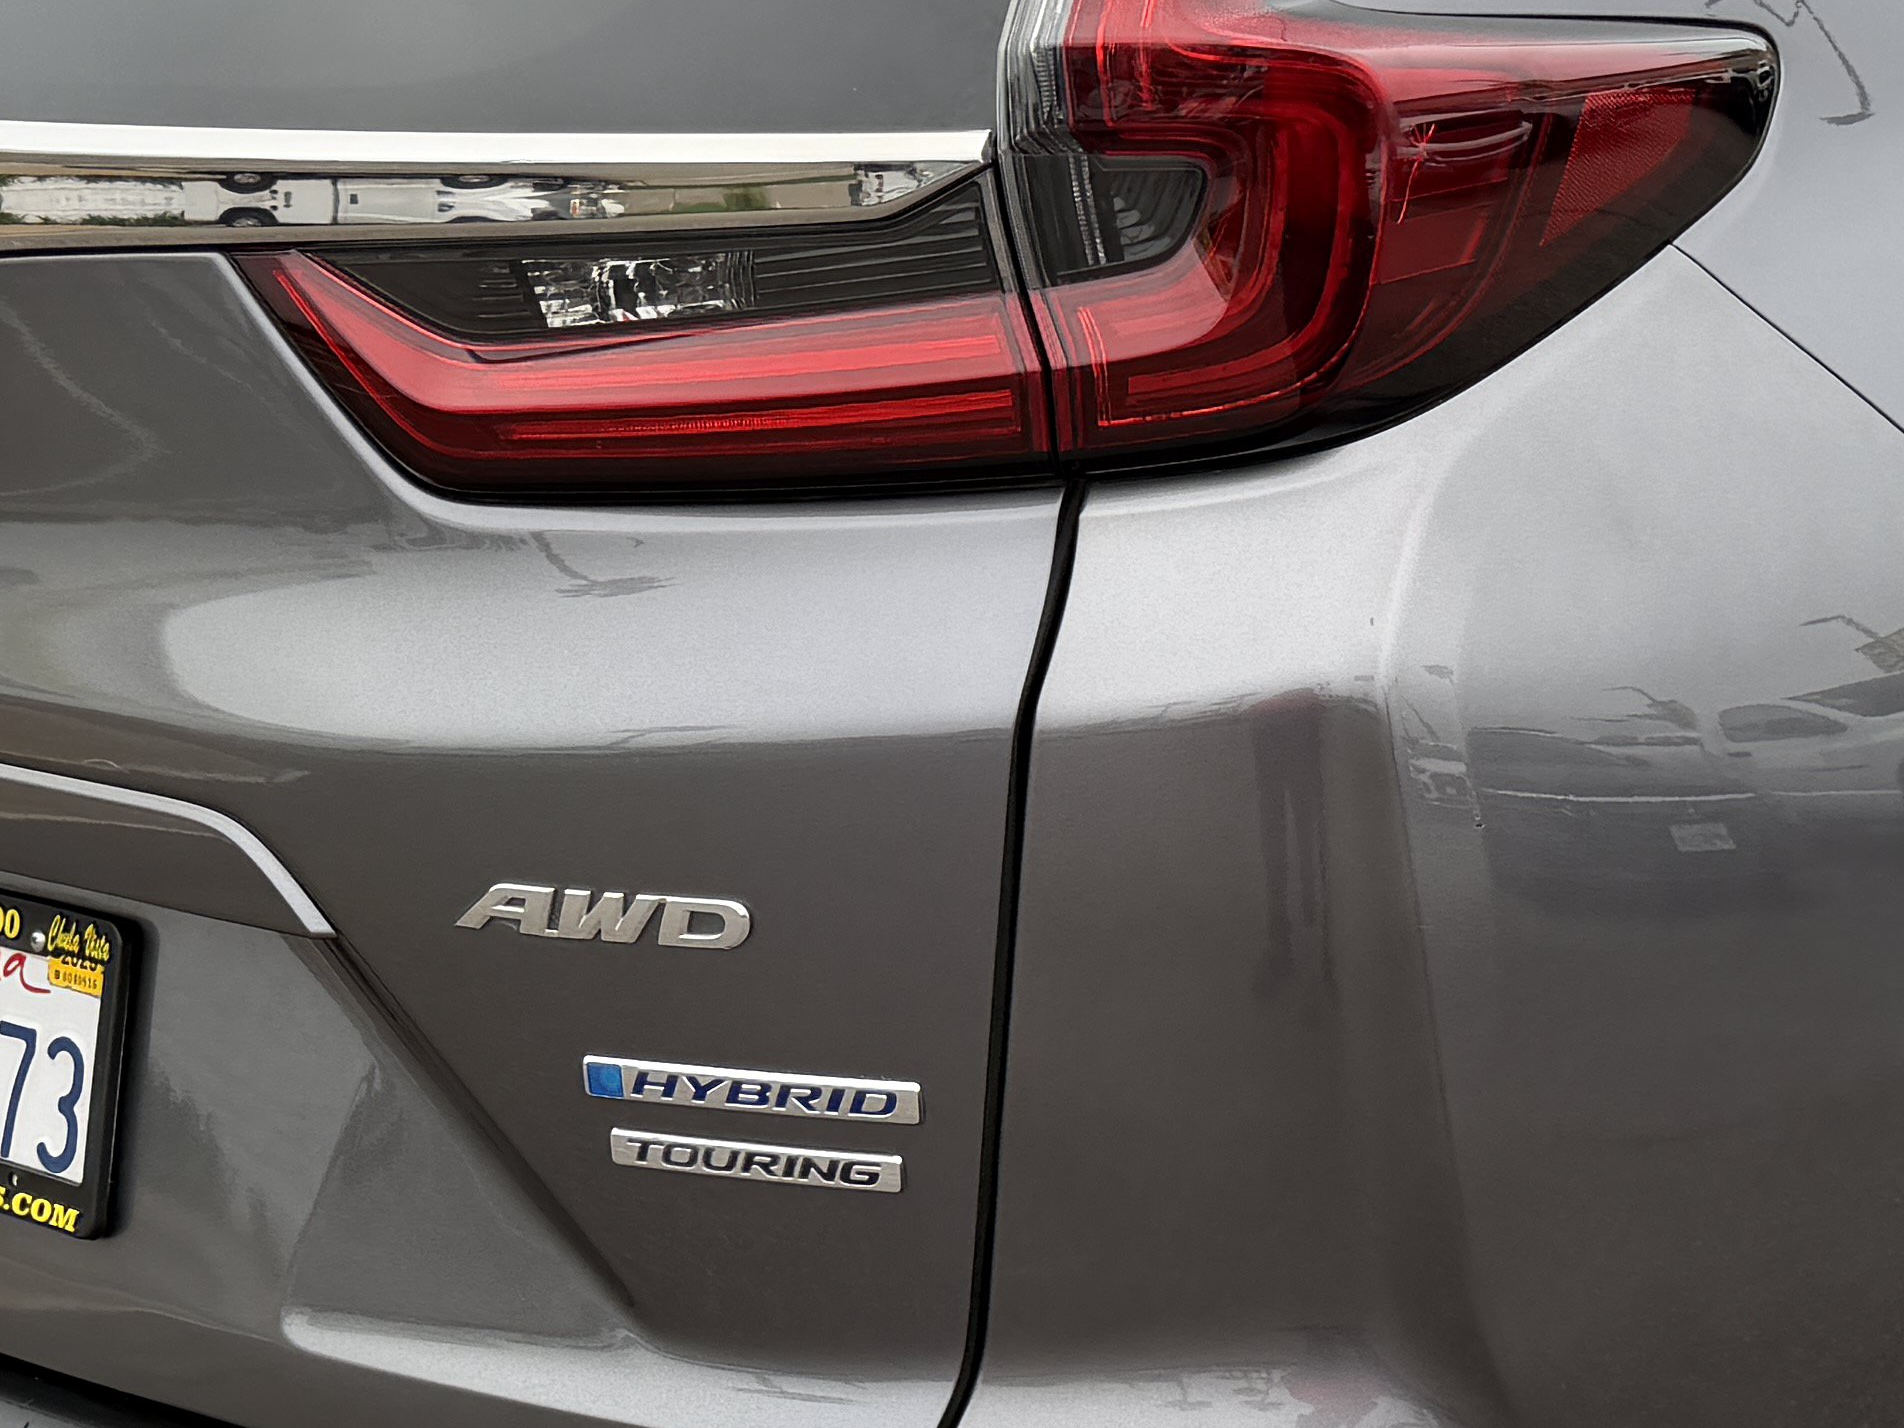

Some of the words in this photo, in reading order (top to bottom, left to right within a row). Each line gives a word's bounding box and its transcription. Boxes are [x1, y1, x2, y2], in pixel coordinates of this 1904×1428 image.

[454, 881, 752, 950] AWD
[629, 1070, 899, 1119] HYBRID
[625, 1136, 883, 1188] TOURING
